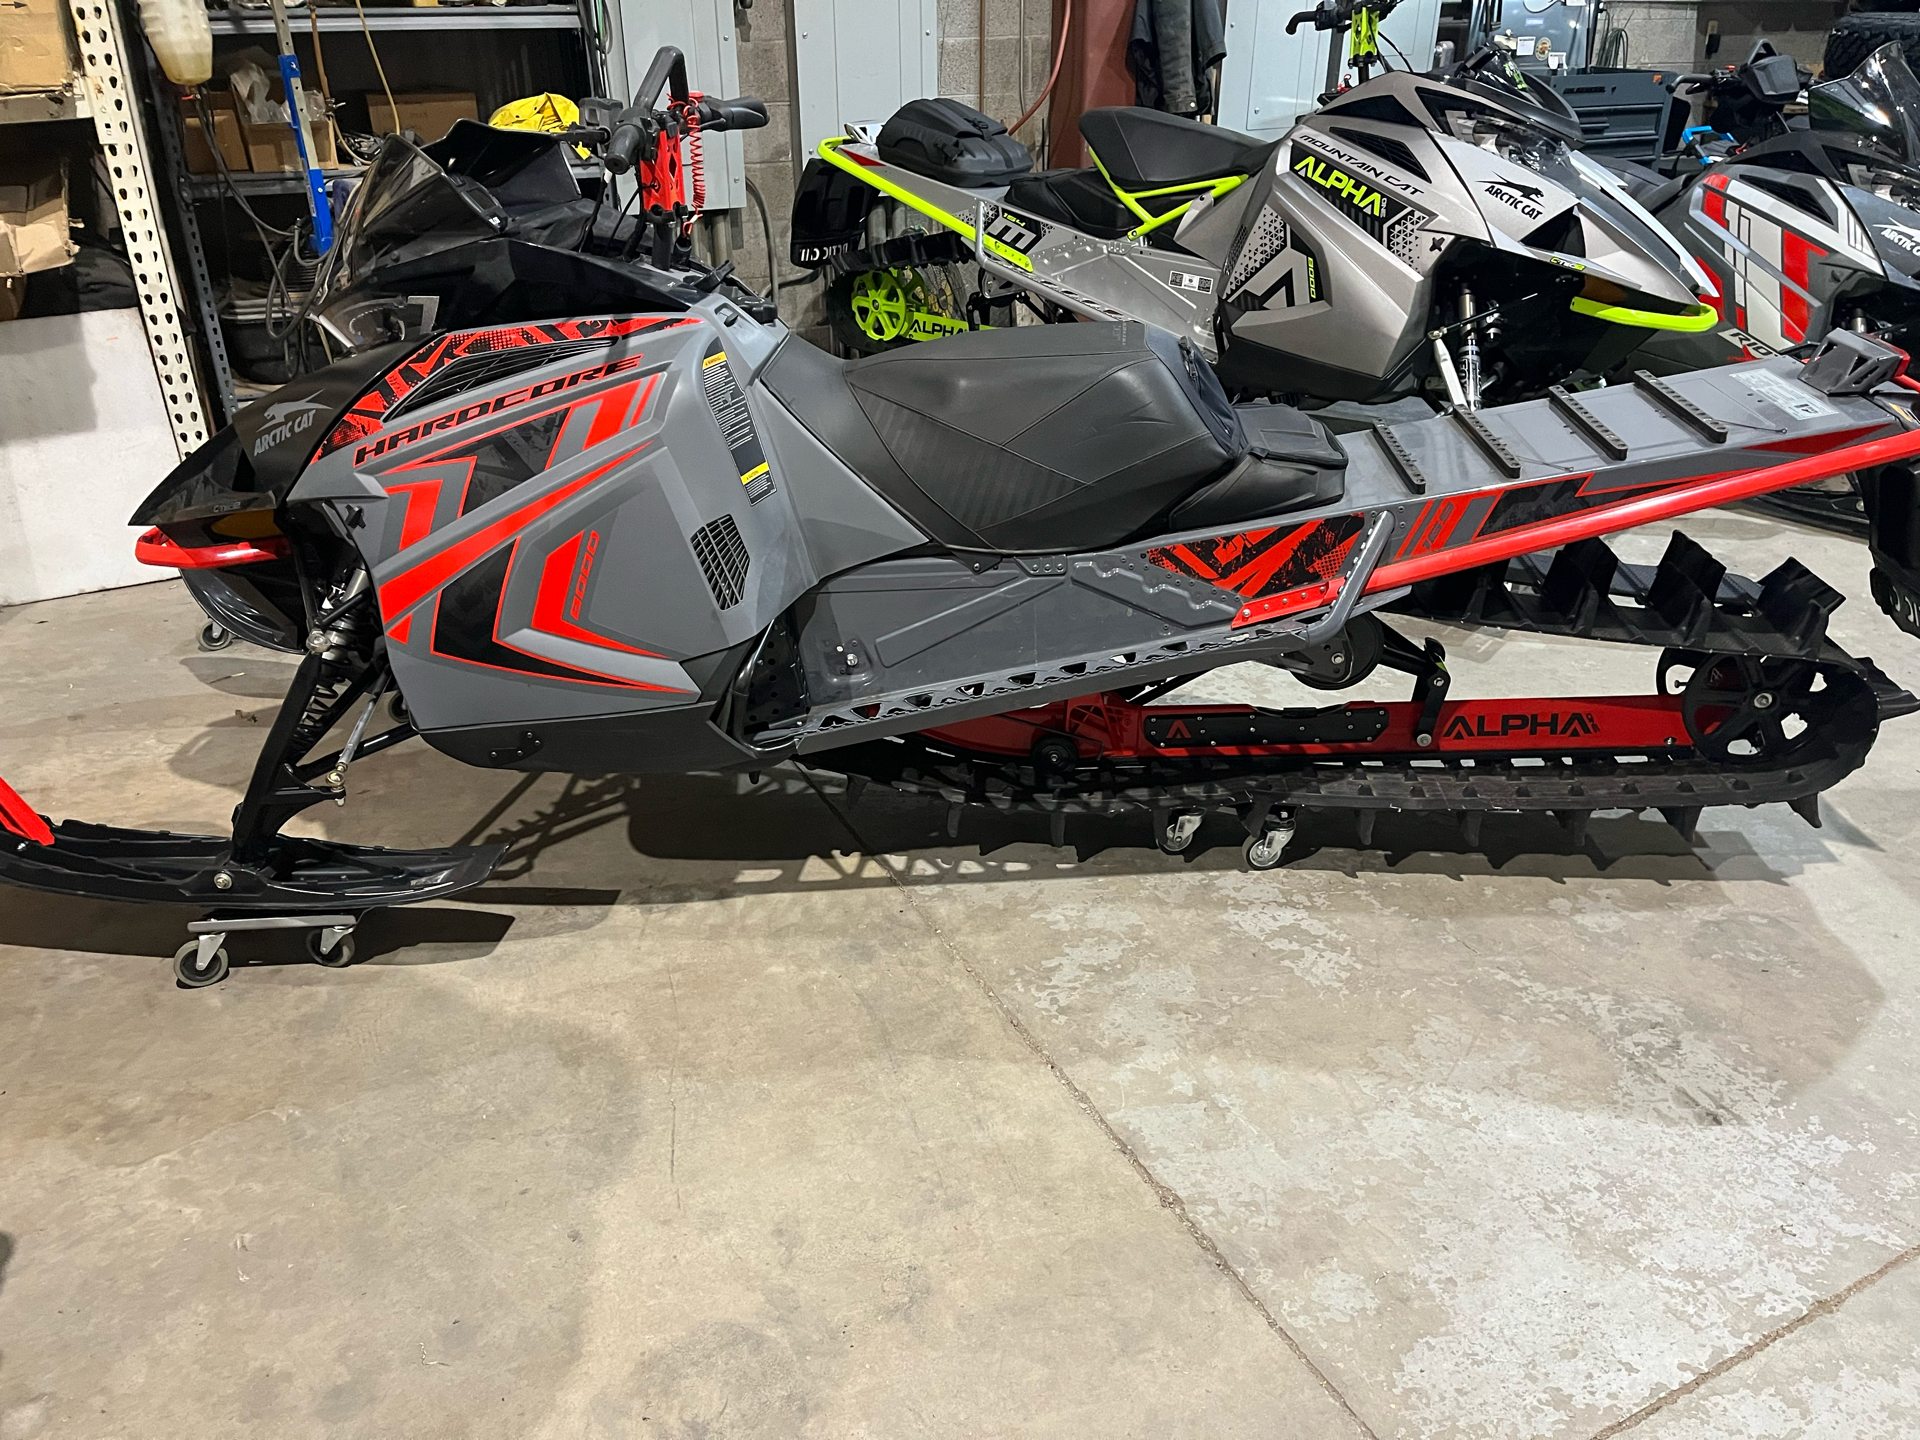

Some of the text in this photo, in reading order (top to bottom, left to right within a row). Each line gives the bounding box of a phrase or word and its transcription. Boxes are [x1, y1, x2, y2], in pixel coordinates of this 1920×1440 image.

[1294, 155, 1381, 217] ALPHA
[1300, 134, 1425, 195] MOUNTAIN CAT
[1003, 212, 1026, 227] 154
[1484, 184, 1543, 220] ARCTIC CAT
[1880, 228, 1916, 251] ARCTIC
[1307, 256, 1316, 299] 8000
[1729, 332, 1778, 357] RIO
[353, 353, 645, 468] HARDCORE
[254, 409, 316, 457] ARCTIC CAT
[570, 529, 600, 621] 8000
[1443, 712, 1592, 740] ALPHA
